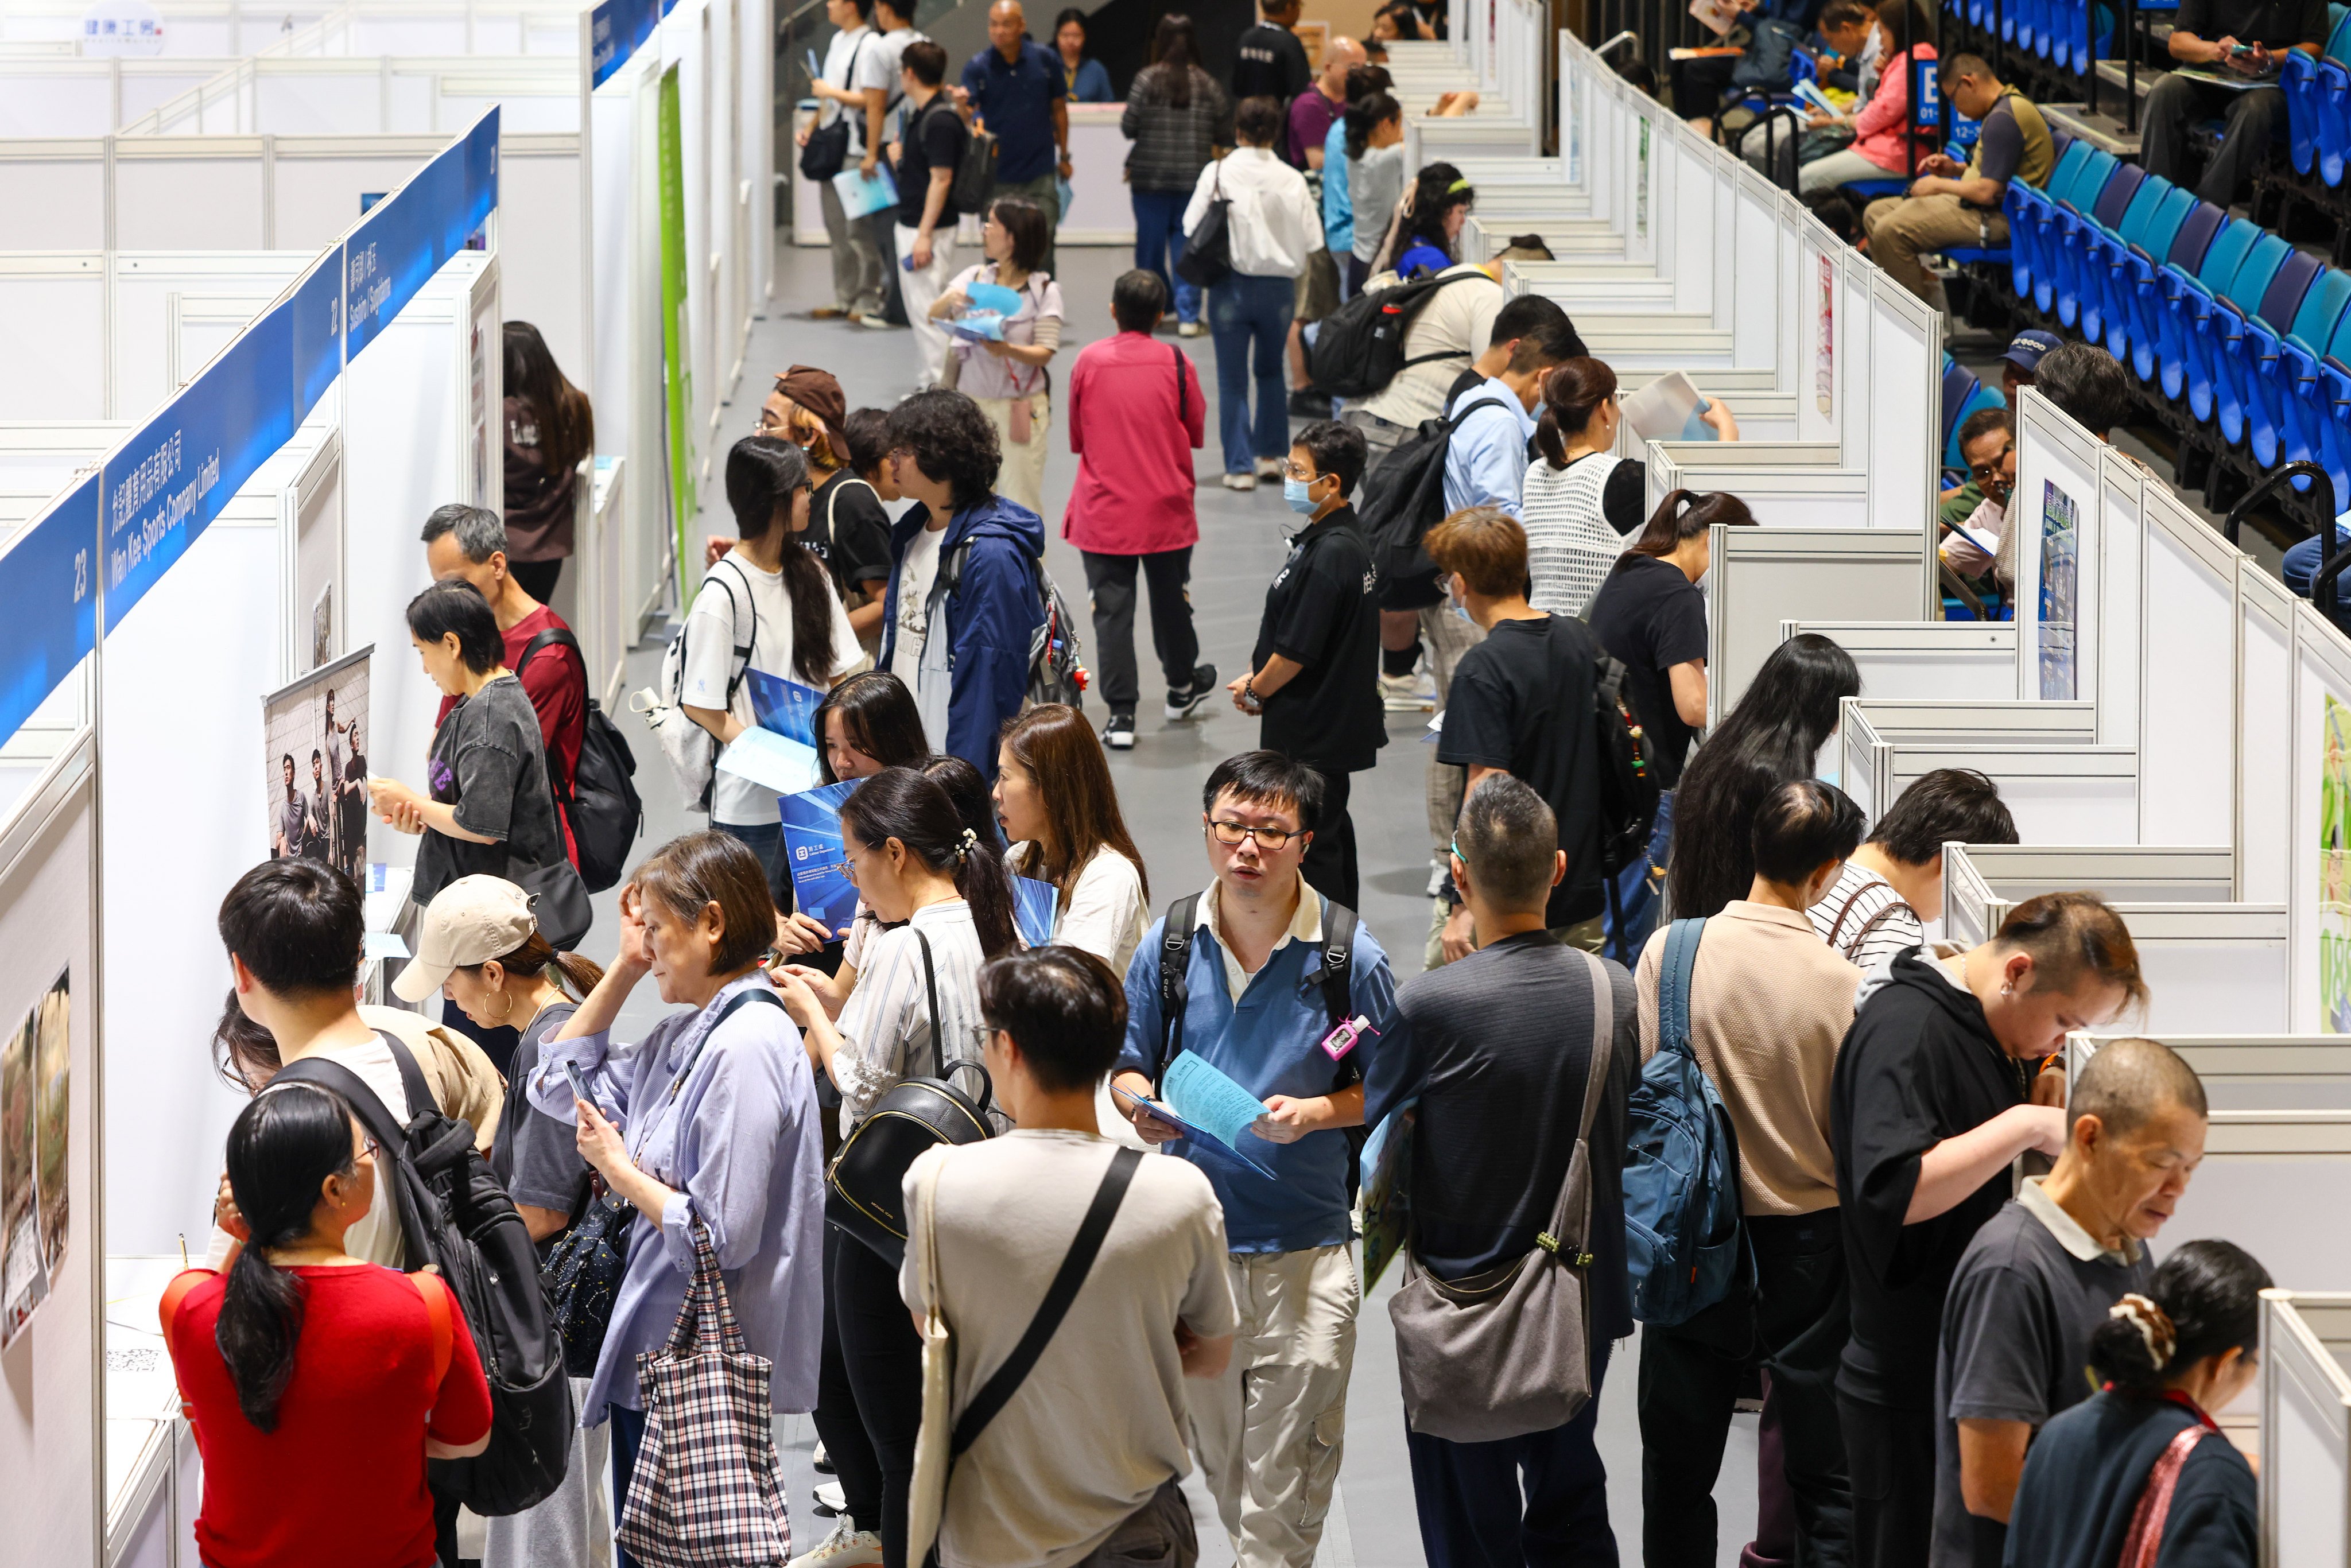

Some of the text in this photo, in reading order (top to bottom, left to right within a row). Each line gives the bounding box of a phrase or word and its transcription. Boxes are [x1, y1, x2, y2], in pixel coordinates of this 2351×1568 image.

[331, 297, 338, 336] 22
[111, 447, 219, 591] Wan Kee Sports Company Limited
[73, 548, 87, 604] 23
